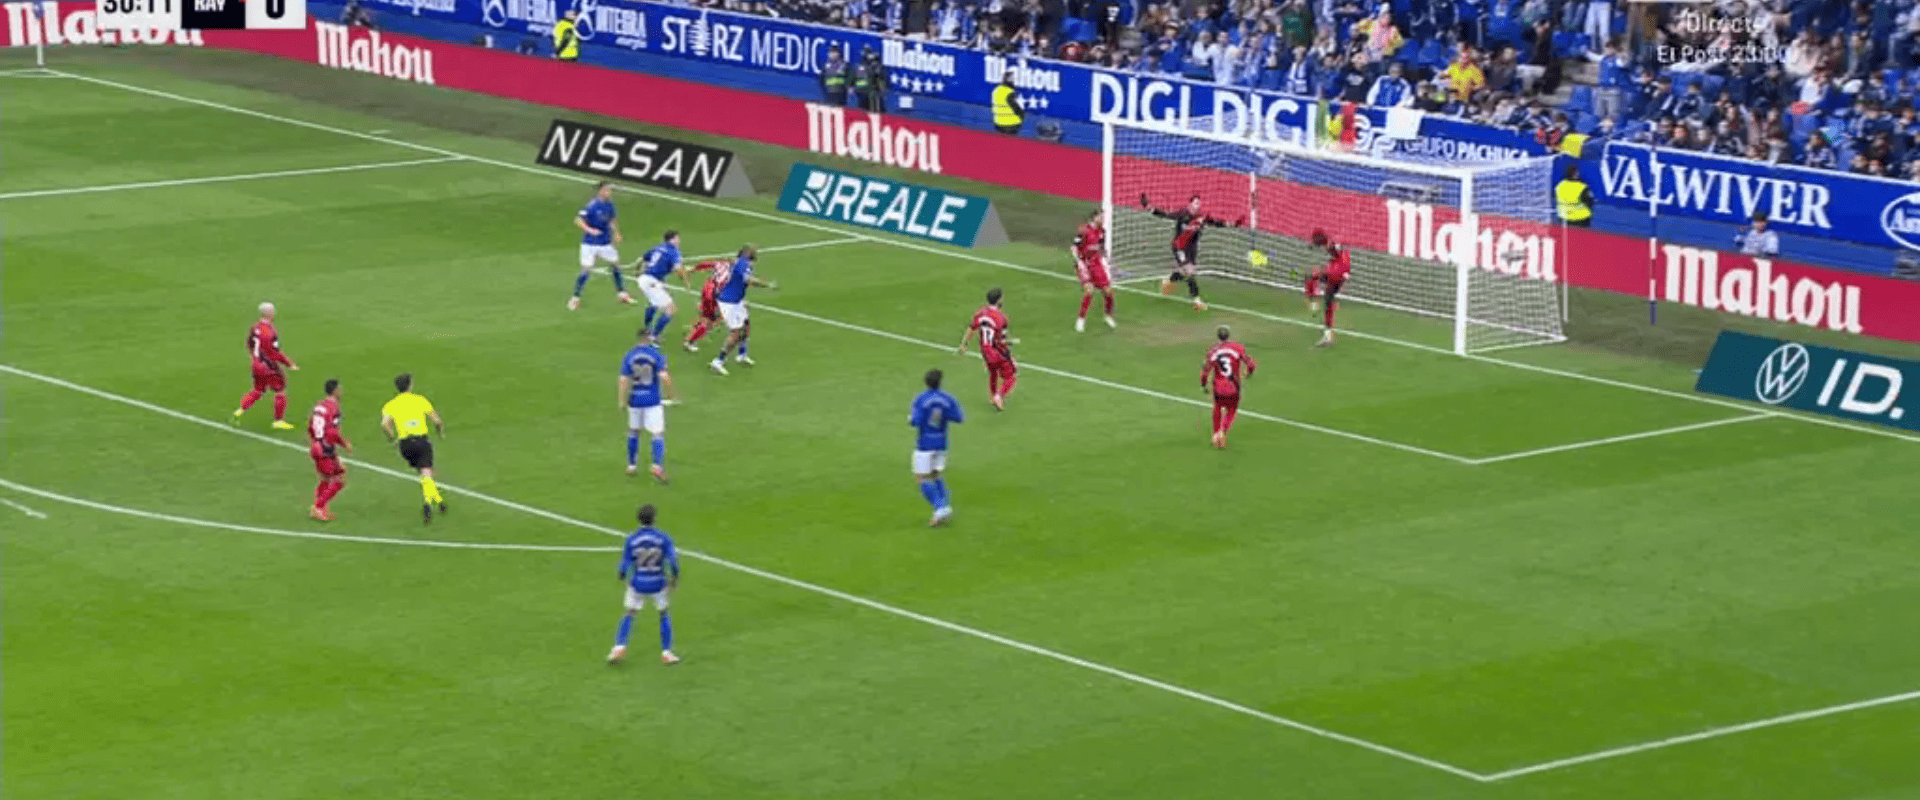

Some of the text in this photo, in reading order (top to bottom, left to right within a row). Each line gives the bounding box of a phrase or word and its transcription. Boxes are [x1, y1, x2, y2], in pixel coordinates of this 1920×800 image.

[315, 21, 436, 84] Mahou
[883, 40, 955, 76] Mahou
[806, 102, 942, 173] Mahou
[1091, 72, 1318, 152] DIGI DIGI
[545, 126, 725, 192] NISSAN
[827, 178, 967, 241] REALE
[1600, 155, 1832, 229] VALWIVER
[1387, 199, 1557, 281] Mahou
[1663, 244, 1863, 333] Mahou
[1219, 357, 1232, 377] 3
[1817, 359, 1905, 419] ID.
[632, 547, 662, 572] 22
